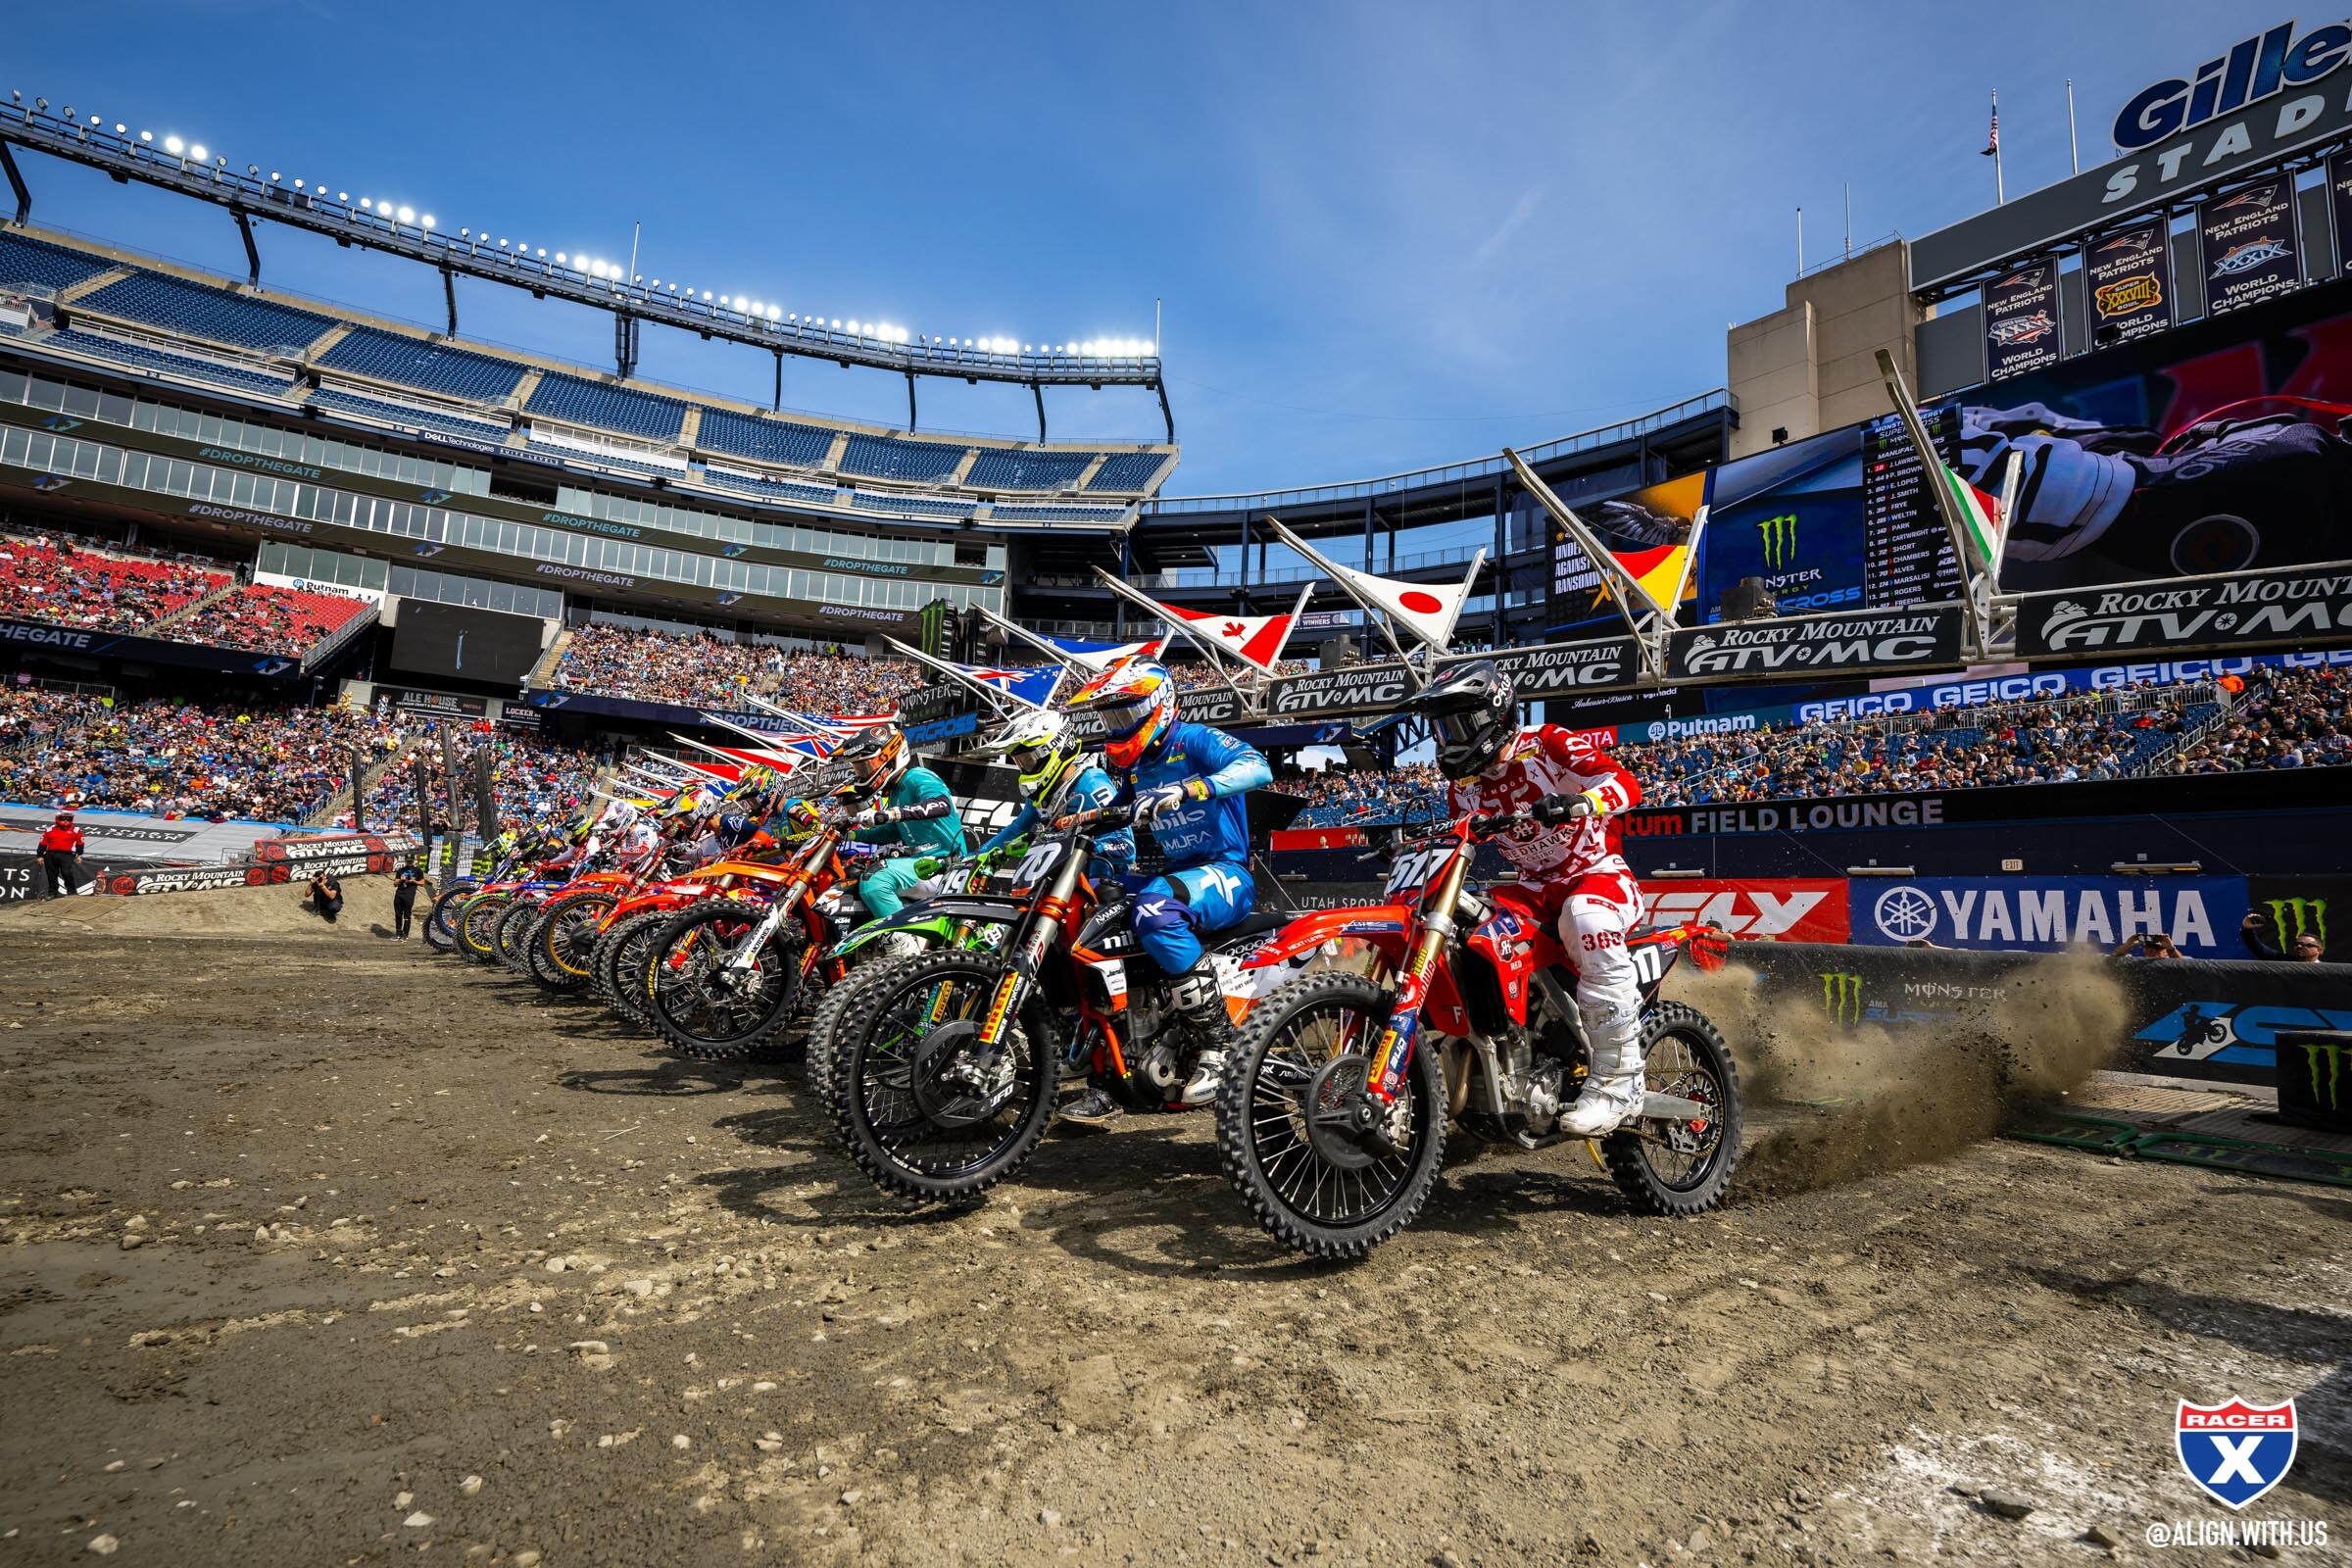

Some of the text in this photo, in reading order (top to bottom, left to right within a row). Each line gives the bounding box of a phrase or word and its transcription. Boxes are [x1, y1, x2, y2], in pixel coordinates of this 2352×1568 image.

[2111, 17, 2352, 152] Gille
[2102, 83, 2352, 203] STAD
[2205, 202, 2289, 236] NEW ENGLAND
[2215, 214, 2278, 241] PATRIOTS
[2089, 246, 2163, 276] NEW ENGLAND
[2098, 257, 2154, 281] PATRIOTS
[2115, 280, 2139, 292] SUPER
[2211, 278, 2295, 310] CHAMPIONS
[2225, 273, 2278, 295] WORLD
[1987, 284, 2053, 312] NEW ENGLAND
[1995, 294, 2045, 316] PATRIOTS
[2117, 301, 2138, 311] BOWL
[2116, 314, 2153, 330] ORLD
[1991, 352, 2057, 378] CHAMPIONS
[2001, 348, 2043, 366] WORLD
[424, 431, 495, 453] DELL Technologies
[199, 447, 321, 479] #DROPTHEGATE
[1897, 466, 1923, 476] BROWN
[1896, 476, 1919, 488] LOPES
[1896, 487, 1919, 498] SMITH
[1891, 501, 1908, 510] FRYE
[1891, 510, 1918, 521] WELTIN
[188, 504, 313, 534] #DROPTHEGATE
[543, 513, 641, 538] #DROPTHEGATE
[1891, 521, 1910, 532] PARK
[1892, 528, 1929, 542] CARTWRIGHT
[1892, 542, 1916, 554] SHORT
[1892, 550, 1930, 564] CHAMBERS
[535, 564, 635, 587] #DROPTHEGATE
[823, 558, 908, 575] #DROPTHEGATE
[1893, 564, 1915, 574] ALVES
[306, 581, 350, 596] Putnam
[1765, 567, 1823, 590] NSTER
[1893, 572, 1931, 585] MARSALISI
[1894, 585, 1922, 597] ROGERS
[1894, 595, 1927, 607] FREEHILL
[2094, 575, 2352, 615] ROCKY MOUNT
[819, 606, 905, 621] #DROPTHEGATE
[1722, 615, 1940, 648] ROCKY MOUNTAIN
[1494, 645, 1623, 672] CKY MOUNTAIN
[1296, 669, 1407, 692] ROCKY MOUNTAIN
[1799, 657, 2252, 723] GEICO GEICO GEICO
[1180, 691, 1235, 709] MOUNTAIN
[1071, 710, 1099, 722] MOUNT
[1668, 713, 1756, 738] Putnam
[1623, 799, 1944, 836] tum FIELD LOUNGE
[297, 838, 364, 851] ROCKY MOUNTAIN
[304, 857, 367, 870] ROCKY MOUNTAIN
[1384, 849, 1455, 895] 517
[2005, 860, 2019, 870] EXIT
[156, 870, 245, 883] ROCKY MOUNTAIN
[1301, 897, 1386, 909] UTAH SPORT
[1095, 904, 1125, 925] NAMURA
[1940, 889, 2217, 948] YAMAHA
[750, 925, 773, 956] MOTOREX
[1629, 945, 1662, 984] 17
[647, 955, 659, 1001] DUNLOP
[1904, 982, 2008, 1003] MONSTER
[979, 972, 1015, 1041] PIRELLI
[1868, 999, 1888, 1008] AMA
